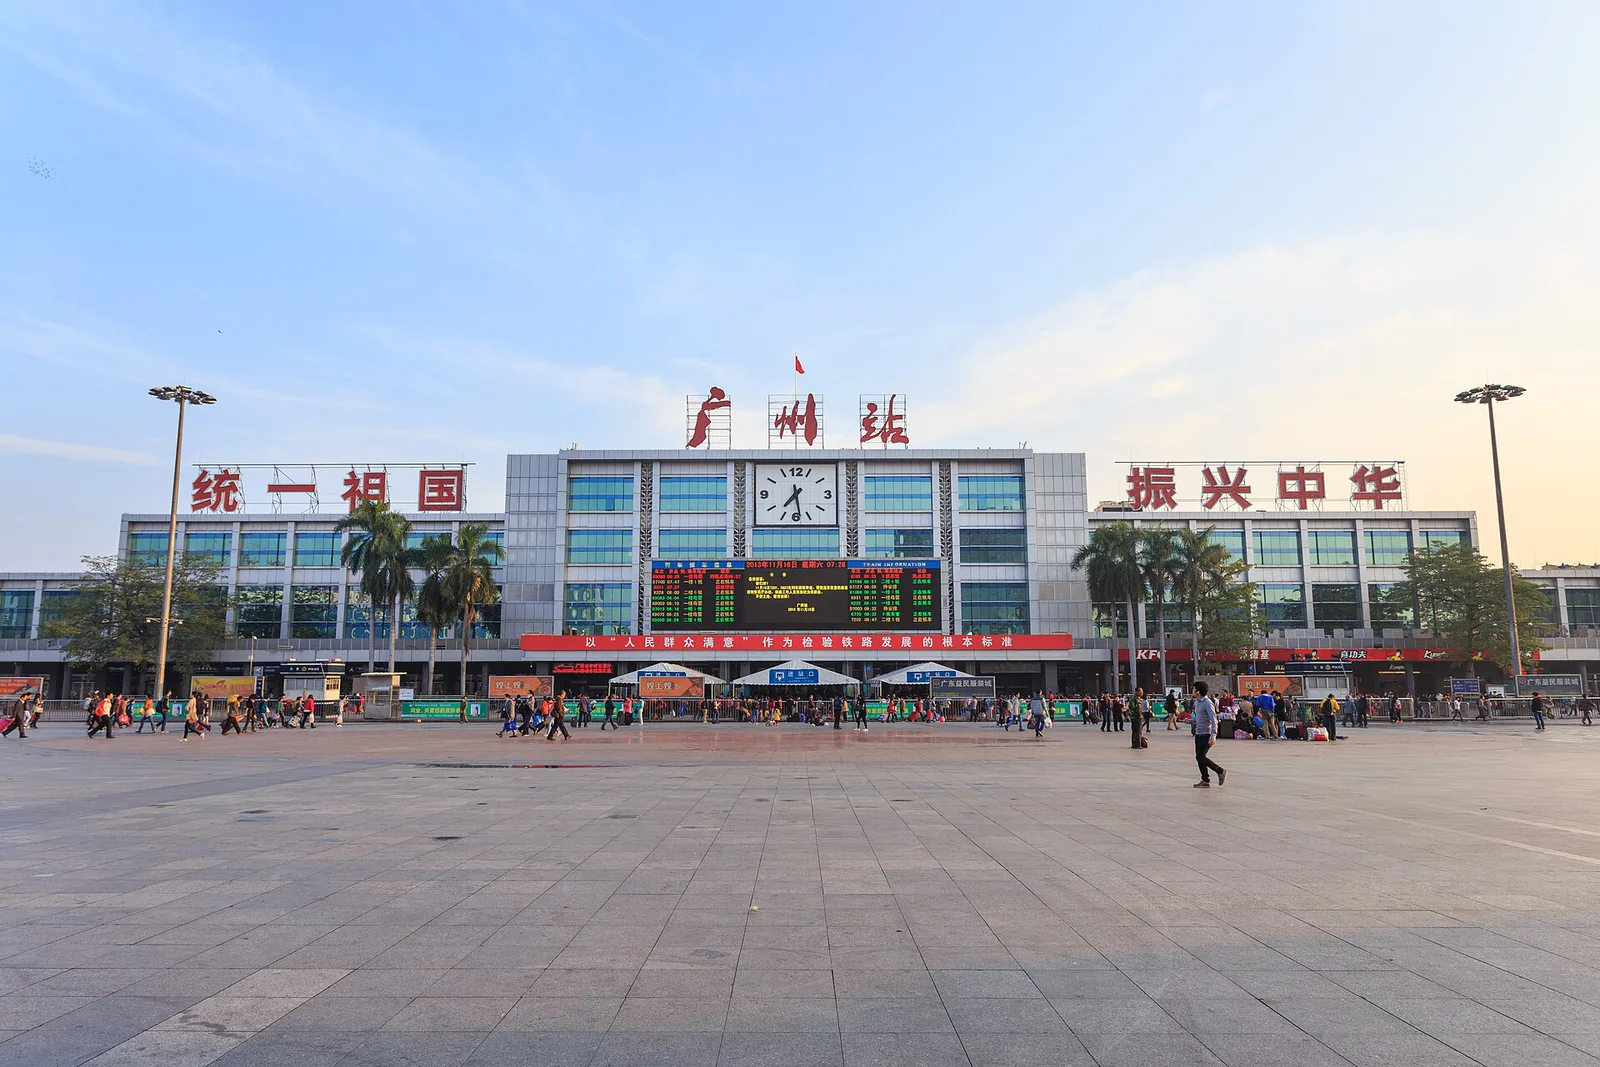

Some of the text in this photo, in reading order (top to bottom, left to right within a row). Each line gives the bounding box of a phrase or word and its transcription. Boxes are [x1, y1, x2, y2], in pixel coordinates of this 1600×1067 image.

[686, 387, 909, 447] 广州站
[789, 467, 803, 477] 12
[191, 469, 464, 512] 统一祖国
[1126, 466, 1402, 510] 振兴中华
[760, 489, 769, 499] 9
[824, 489, 832, 499] 3
[791, 512, 801, 521] 6
[585, 636, 1013, 648] 以“人民群众满意”作为检验铁路发展的根本标准
[1340, 650, 1366, 659] 真功夫
[940, 679, 992, 687] 广东益民服装城
[1526, 677, 1579, 686] 广东益民服装城
